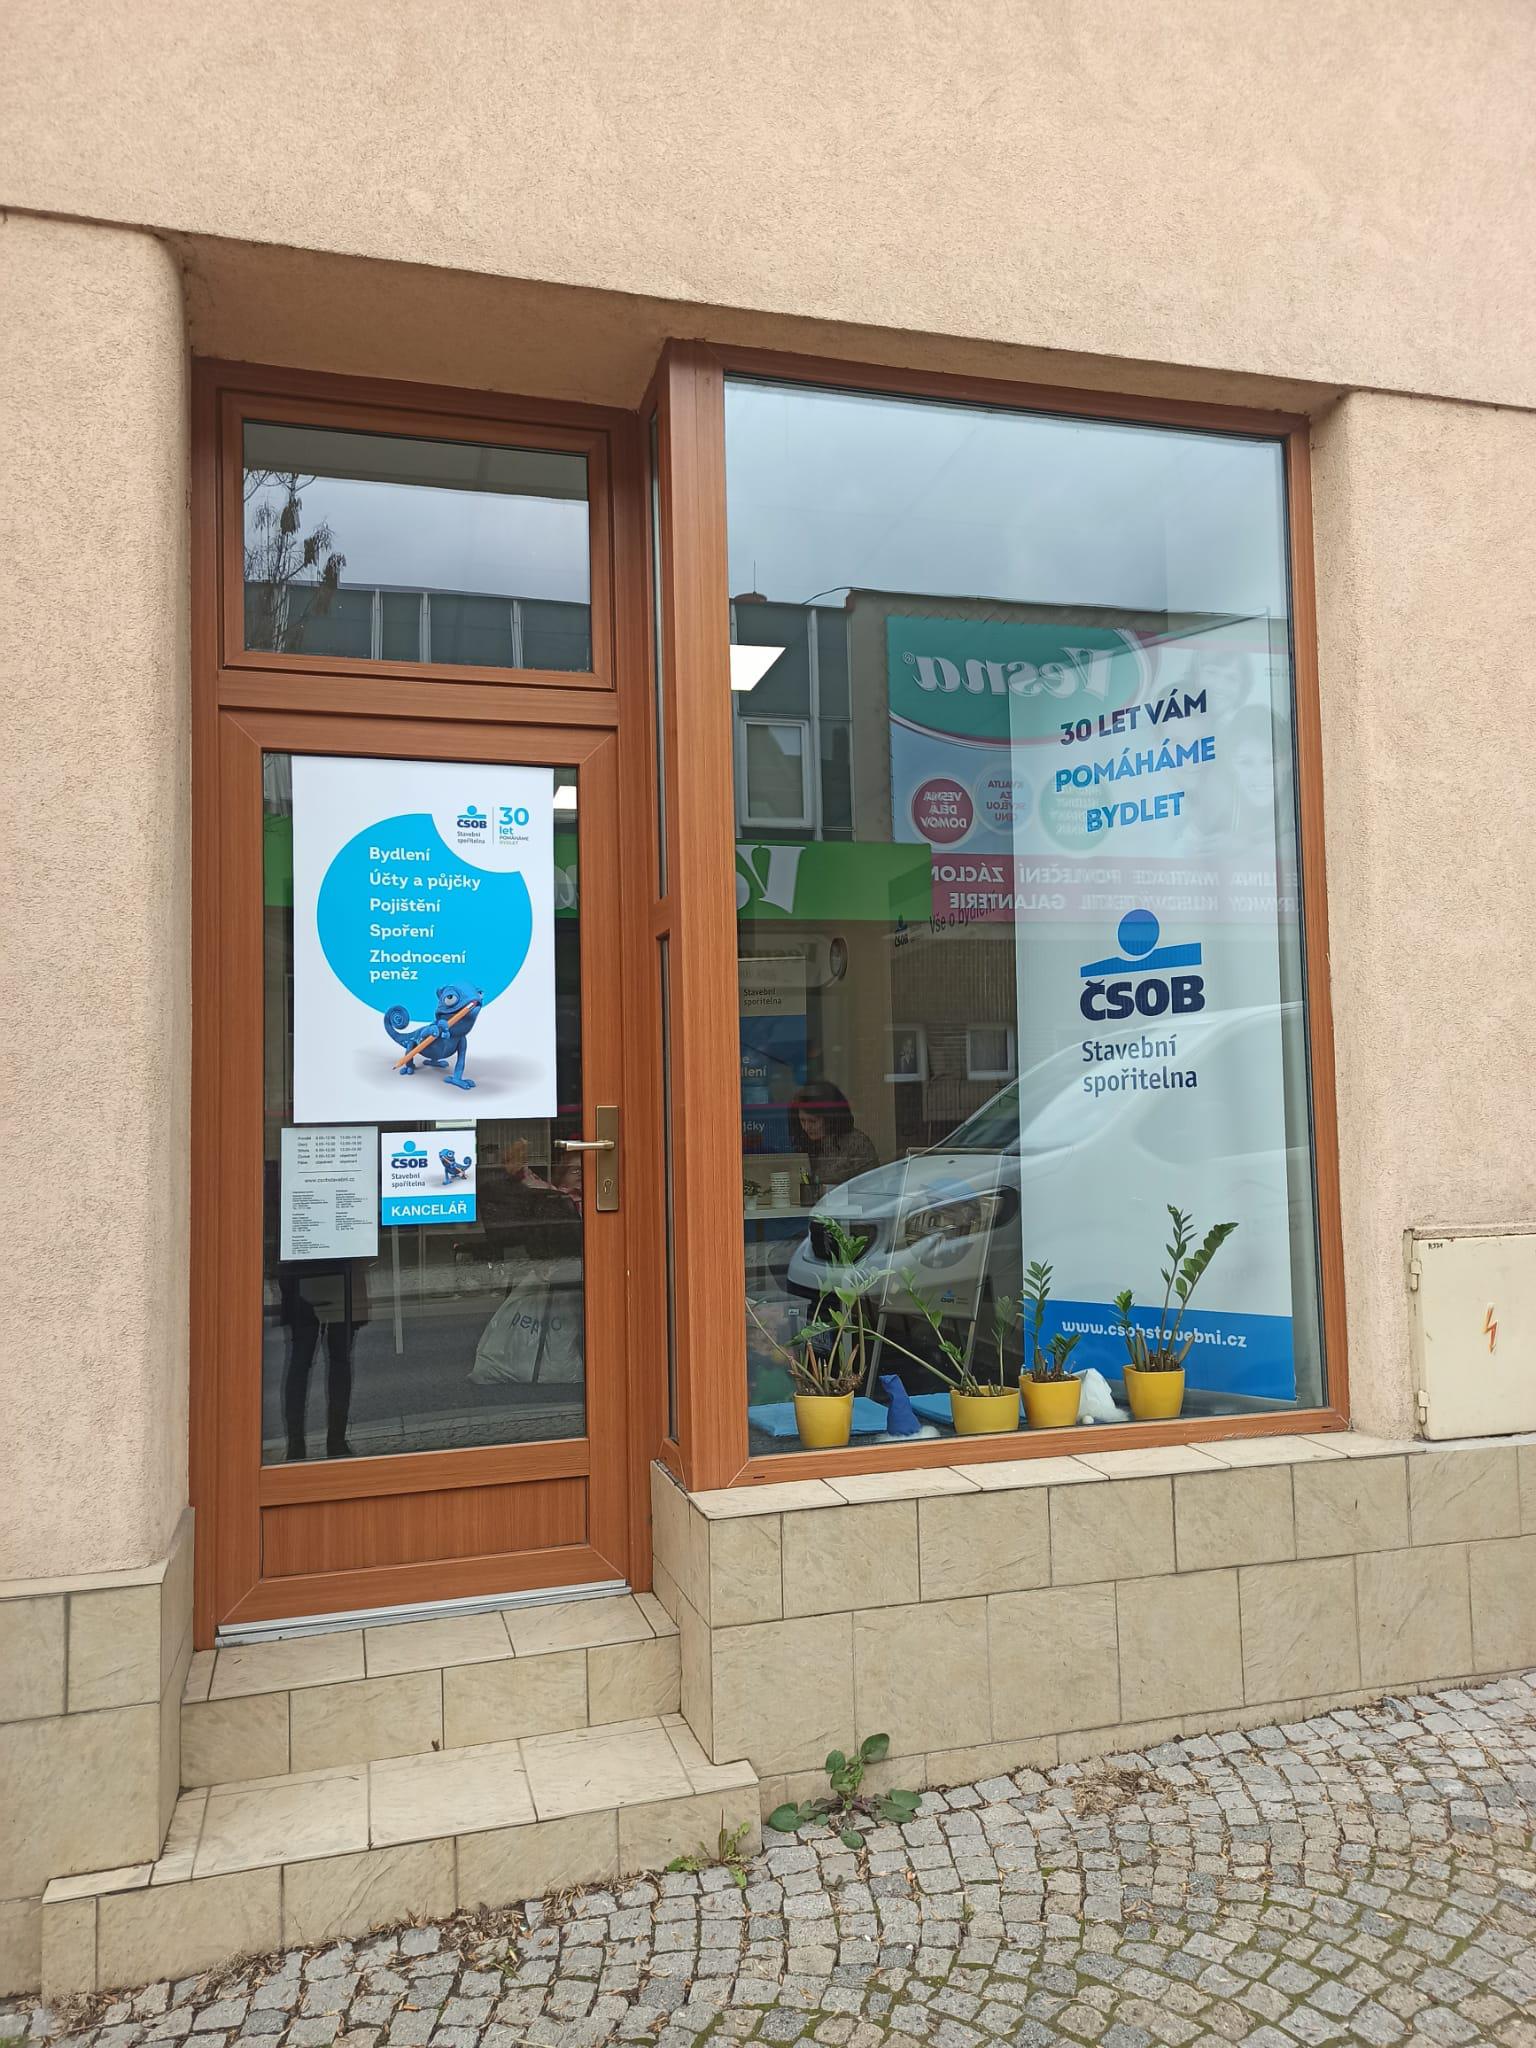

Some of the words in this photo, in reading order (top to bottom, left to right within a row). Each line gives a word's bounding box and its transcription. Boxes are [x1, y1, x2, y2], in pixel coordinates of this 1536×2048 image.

[1060, 718, 1092, 746] 30
[1098, 706, 1141, 737] LET
[1144, 688, 1207, 725] VÁM
[1055, 736, 1216, 792] POMÁHÁME
[499, 806, 530, 826] 30
[1086, 791, 1185, 833] BYDLET
[499, 826, 514, 835] let
[369, 846, 431, 864] Bydlení
[369, 868, 409, 889] Účty
[413, 877, 423, 887] a
[427, 872, 481, 891] půjčky
[369, 897, 441, 915] Pojištění
[948, 912, 956, 927] o
[369, 923, 435, 940] Spoření
[369, 949, 467, 964] Zhodnocení
[369, 966, 419, 983] peněz
[1079, 974, 1206, 1022] ČSOB
[1081, 1033, 1178, 1063] Stavební
[1083, 1065, 1198, 1098] spořitelna
[391, 1157, 428, 1169] ČSOB
[391, 1172, 421, 1180] Stavební
[391, 1179, 426, 1188] spořitelna
[391, 1200, 468, 1217] KANCELÁŘ
[510, 1311, 562, 1336] pepo
